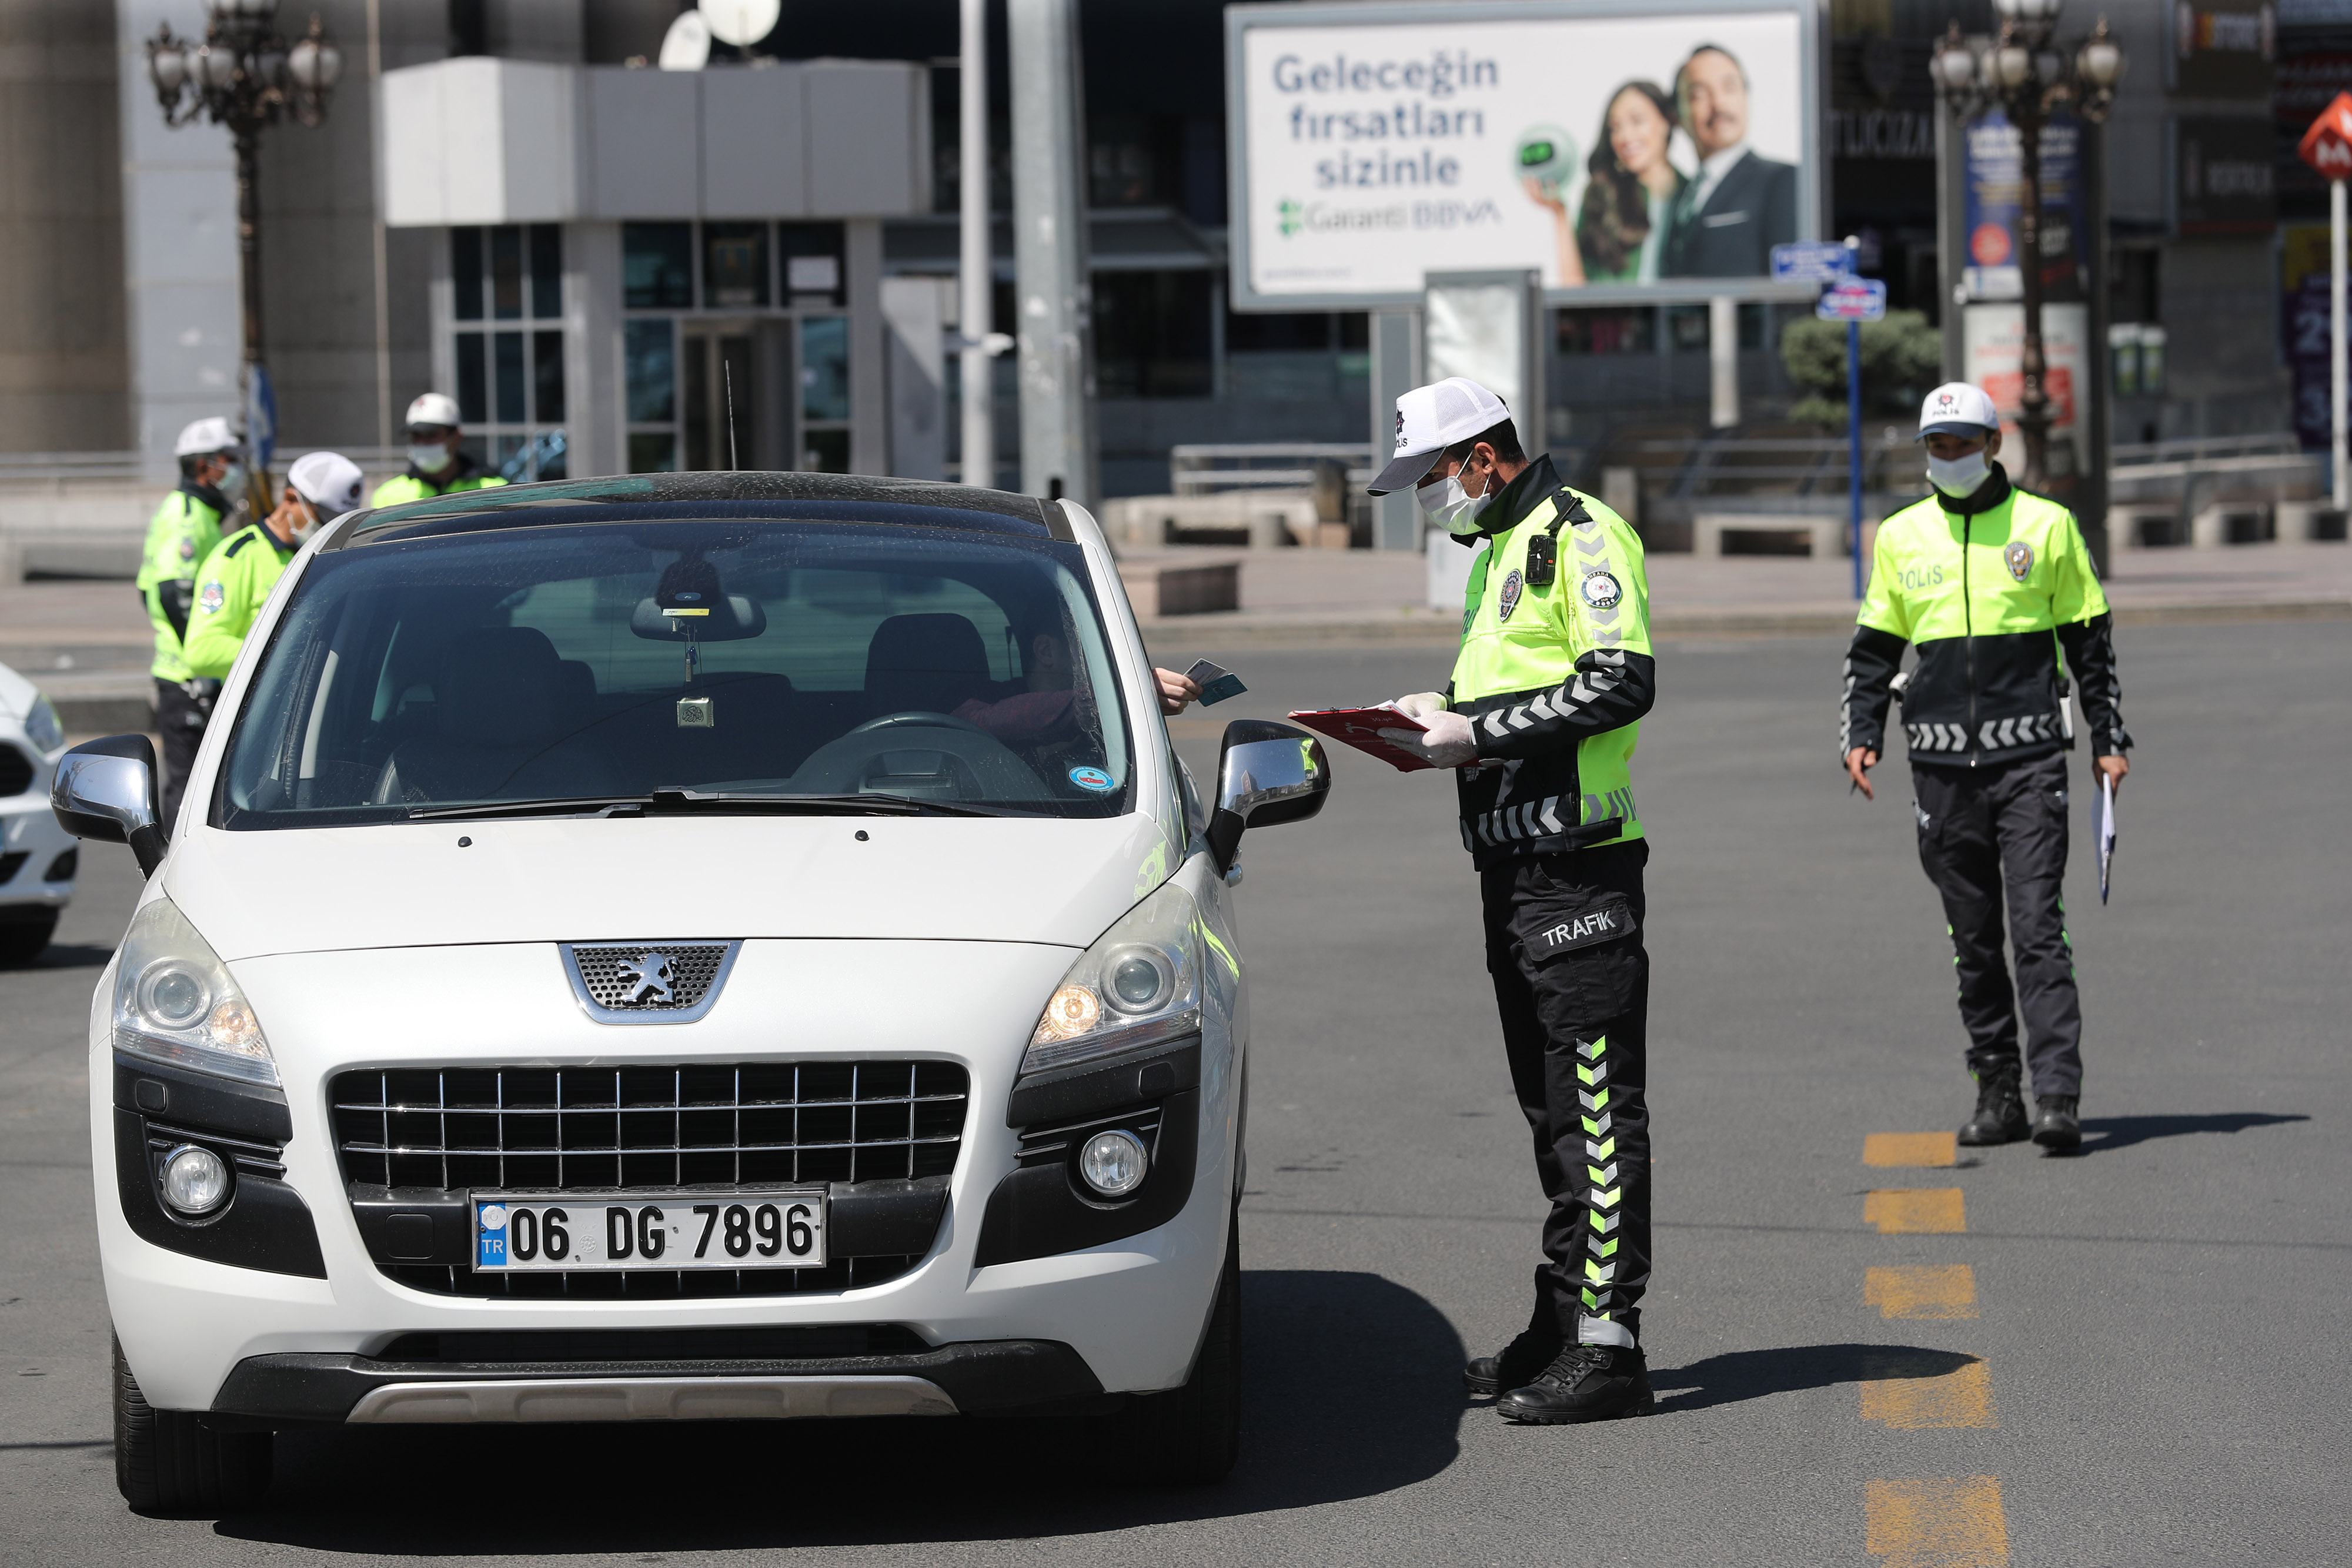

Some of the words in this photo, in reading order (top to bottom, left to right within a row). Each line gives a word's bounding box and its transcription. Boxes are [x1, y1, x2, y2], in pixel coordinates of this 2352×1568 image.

[1273, 50, 1499, 99] Geleceğin
[1289, 102, 1483, 140] fırsatları
[1316, 149, 1461, 189] sizinle
[1305, 200, 1408, 232] Garanti
[1413, 198, 1502, 229] BBVA
[482, 1239, 503, 1253] TR
[511, 1207, 569, 1261] 06
[606, 1205, 665, 1259] DG
[693, 1203, 813, 1258] 7896
